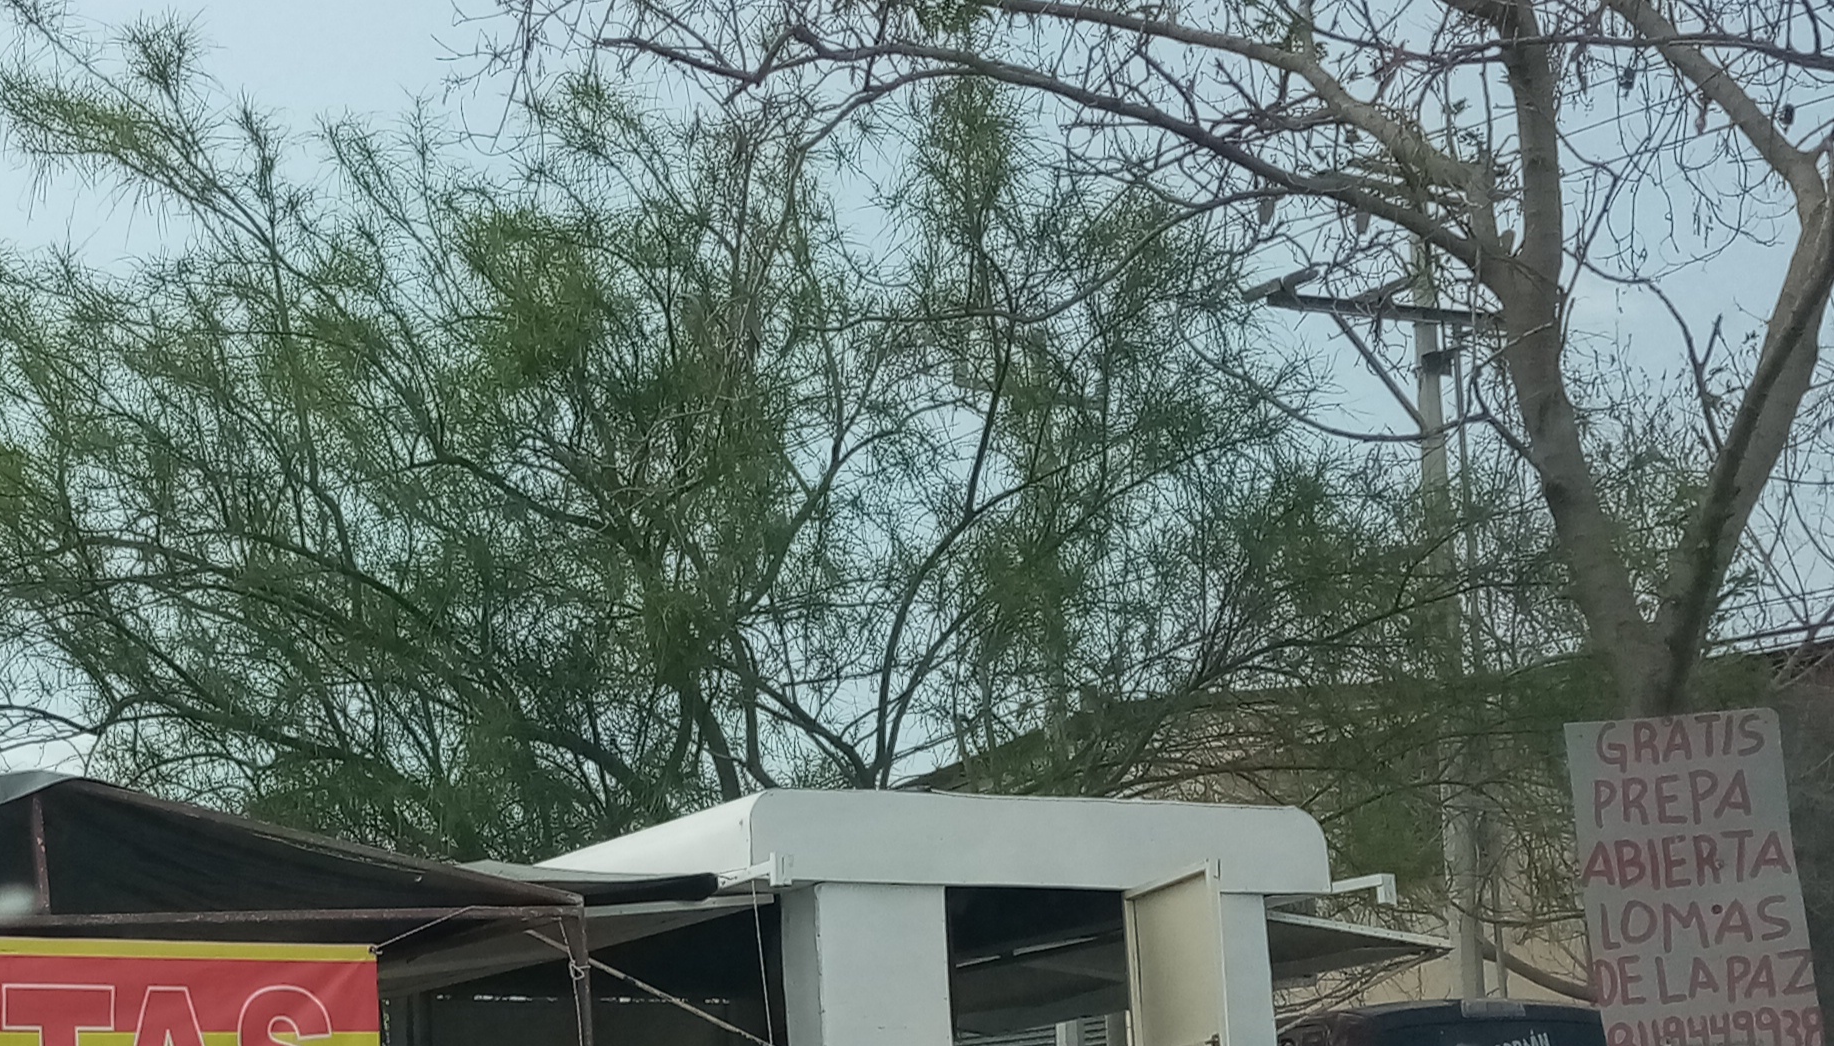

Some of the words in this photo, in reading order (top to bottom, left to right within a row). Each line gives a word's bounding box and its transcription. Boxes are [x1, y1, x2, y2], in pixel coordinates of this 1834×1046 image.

[1595, 712, 1766, 773] GRATIS
[1593, 769, 1753, 829] PREPA
[1581, 829, 1793, 890] ABIERTA
[1599, 895, 1793, 953] LOMAS
[1593, 955, 1647, 1008] DE
[1654, 955, 1720, 1005] LA
[1725, 948, 1817, 1004] PAZ
